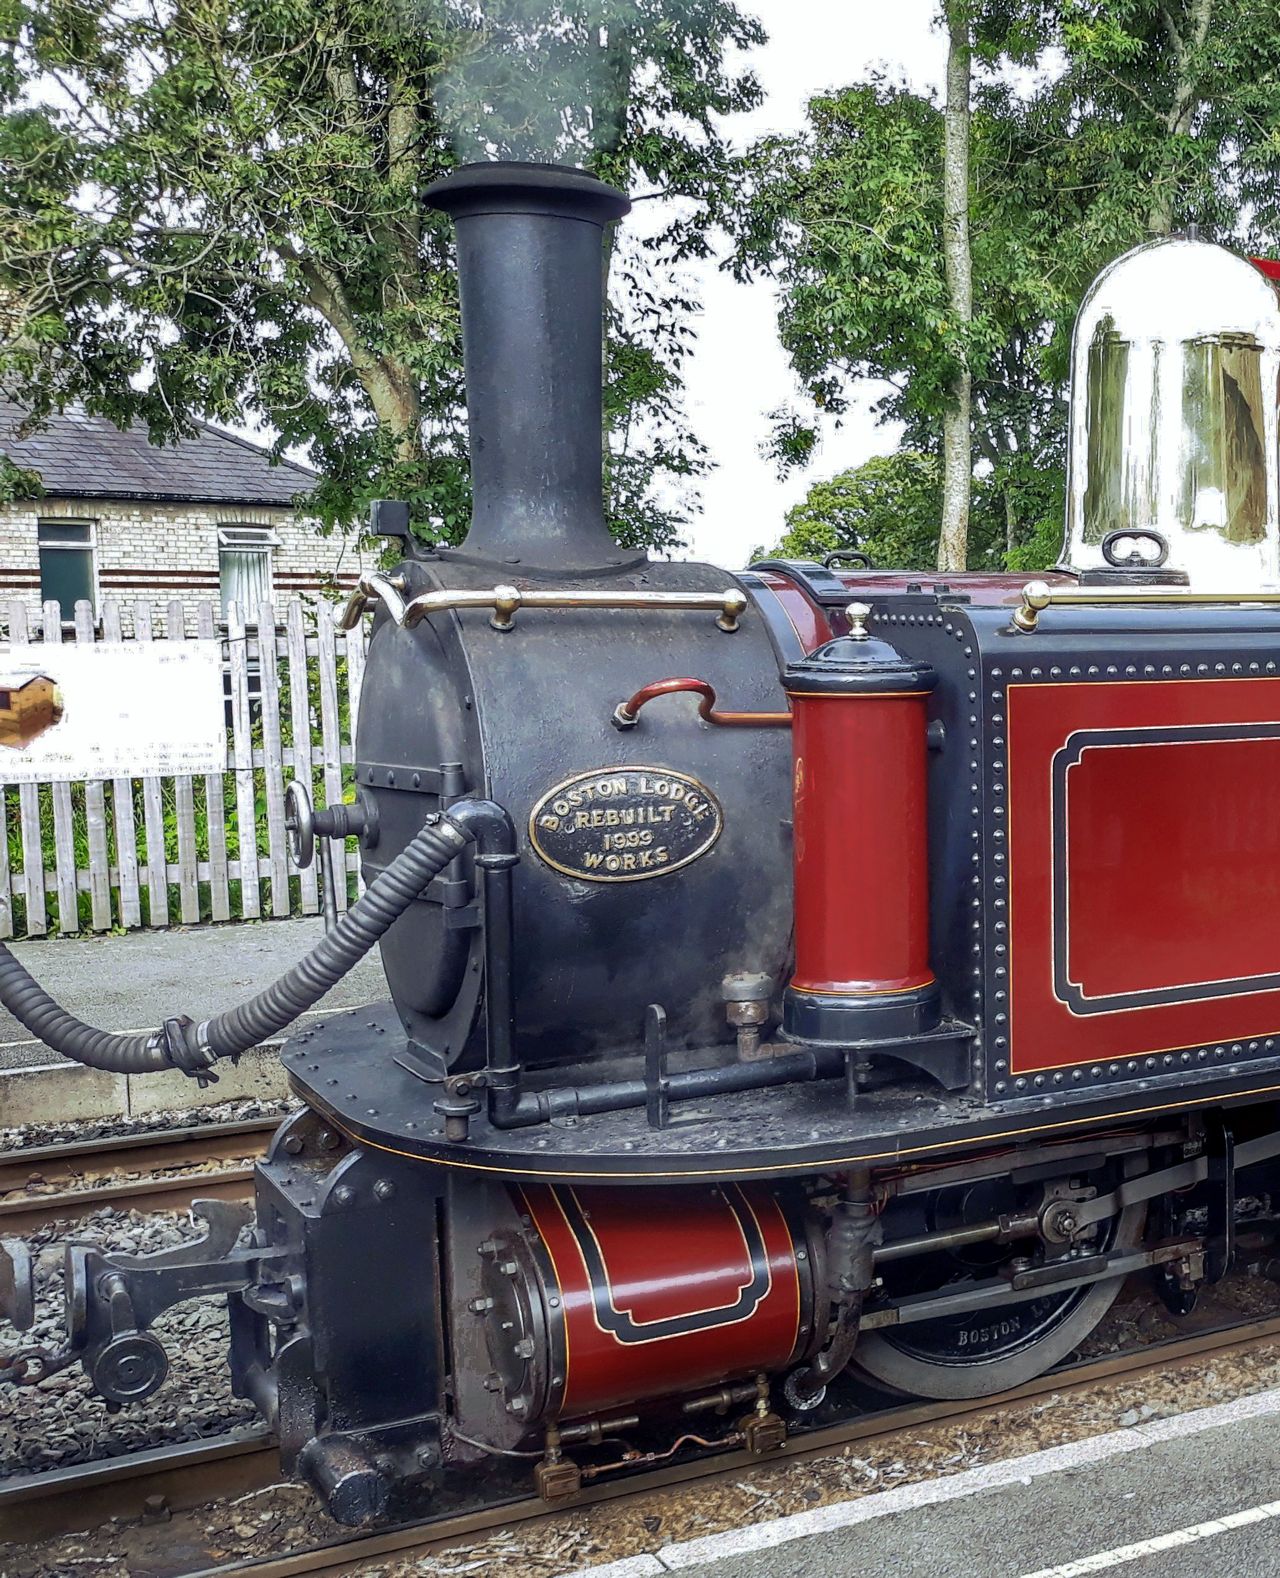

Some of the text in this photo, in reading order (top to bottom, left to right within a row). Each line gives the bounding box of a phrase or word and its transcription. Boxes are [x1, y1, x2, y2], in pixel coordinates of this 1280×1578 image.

[540, 777, 710, 833] BOSTON LODGE
[576, 805, 676, 829] REBUILT
[603, 830, 654, 851] 1999
[584, 846, 669, 871] WORKS
[957, 1316, 1021, 1347] BOSTON
